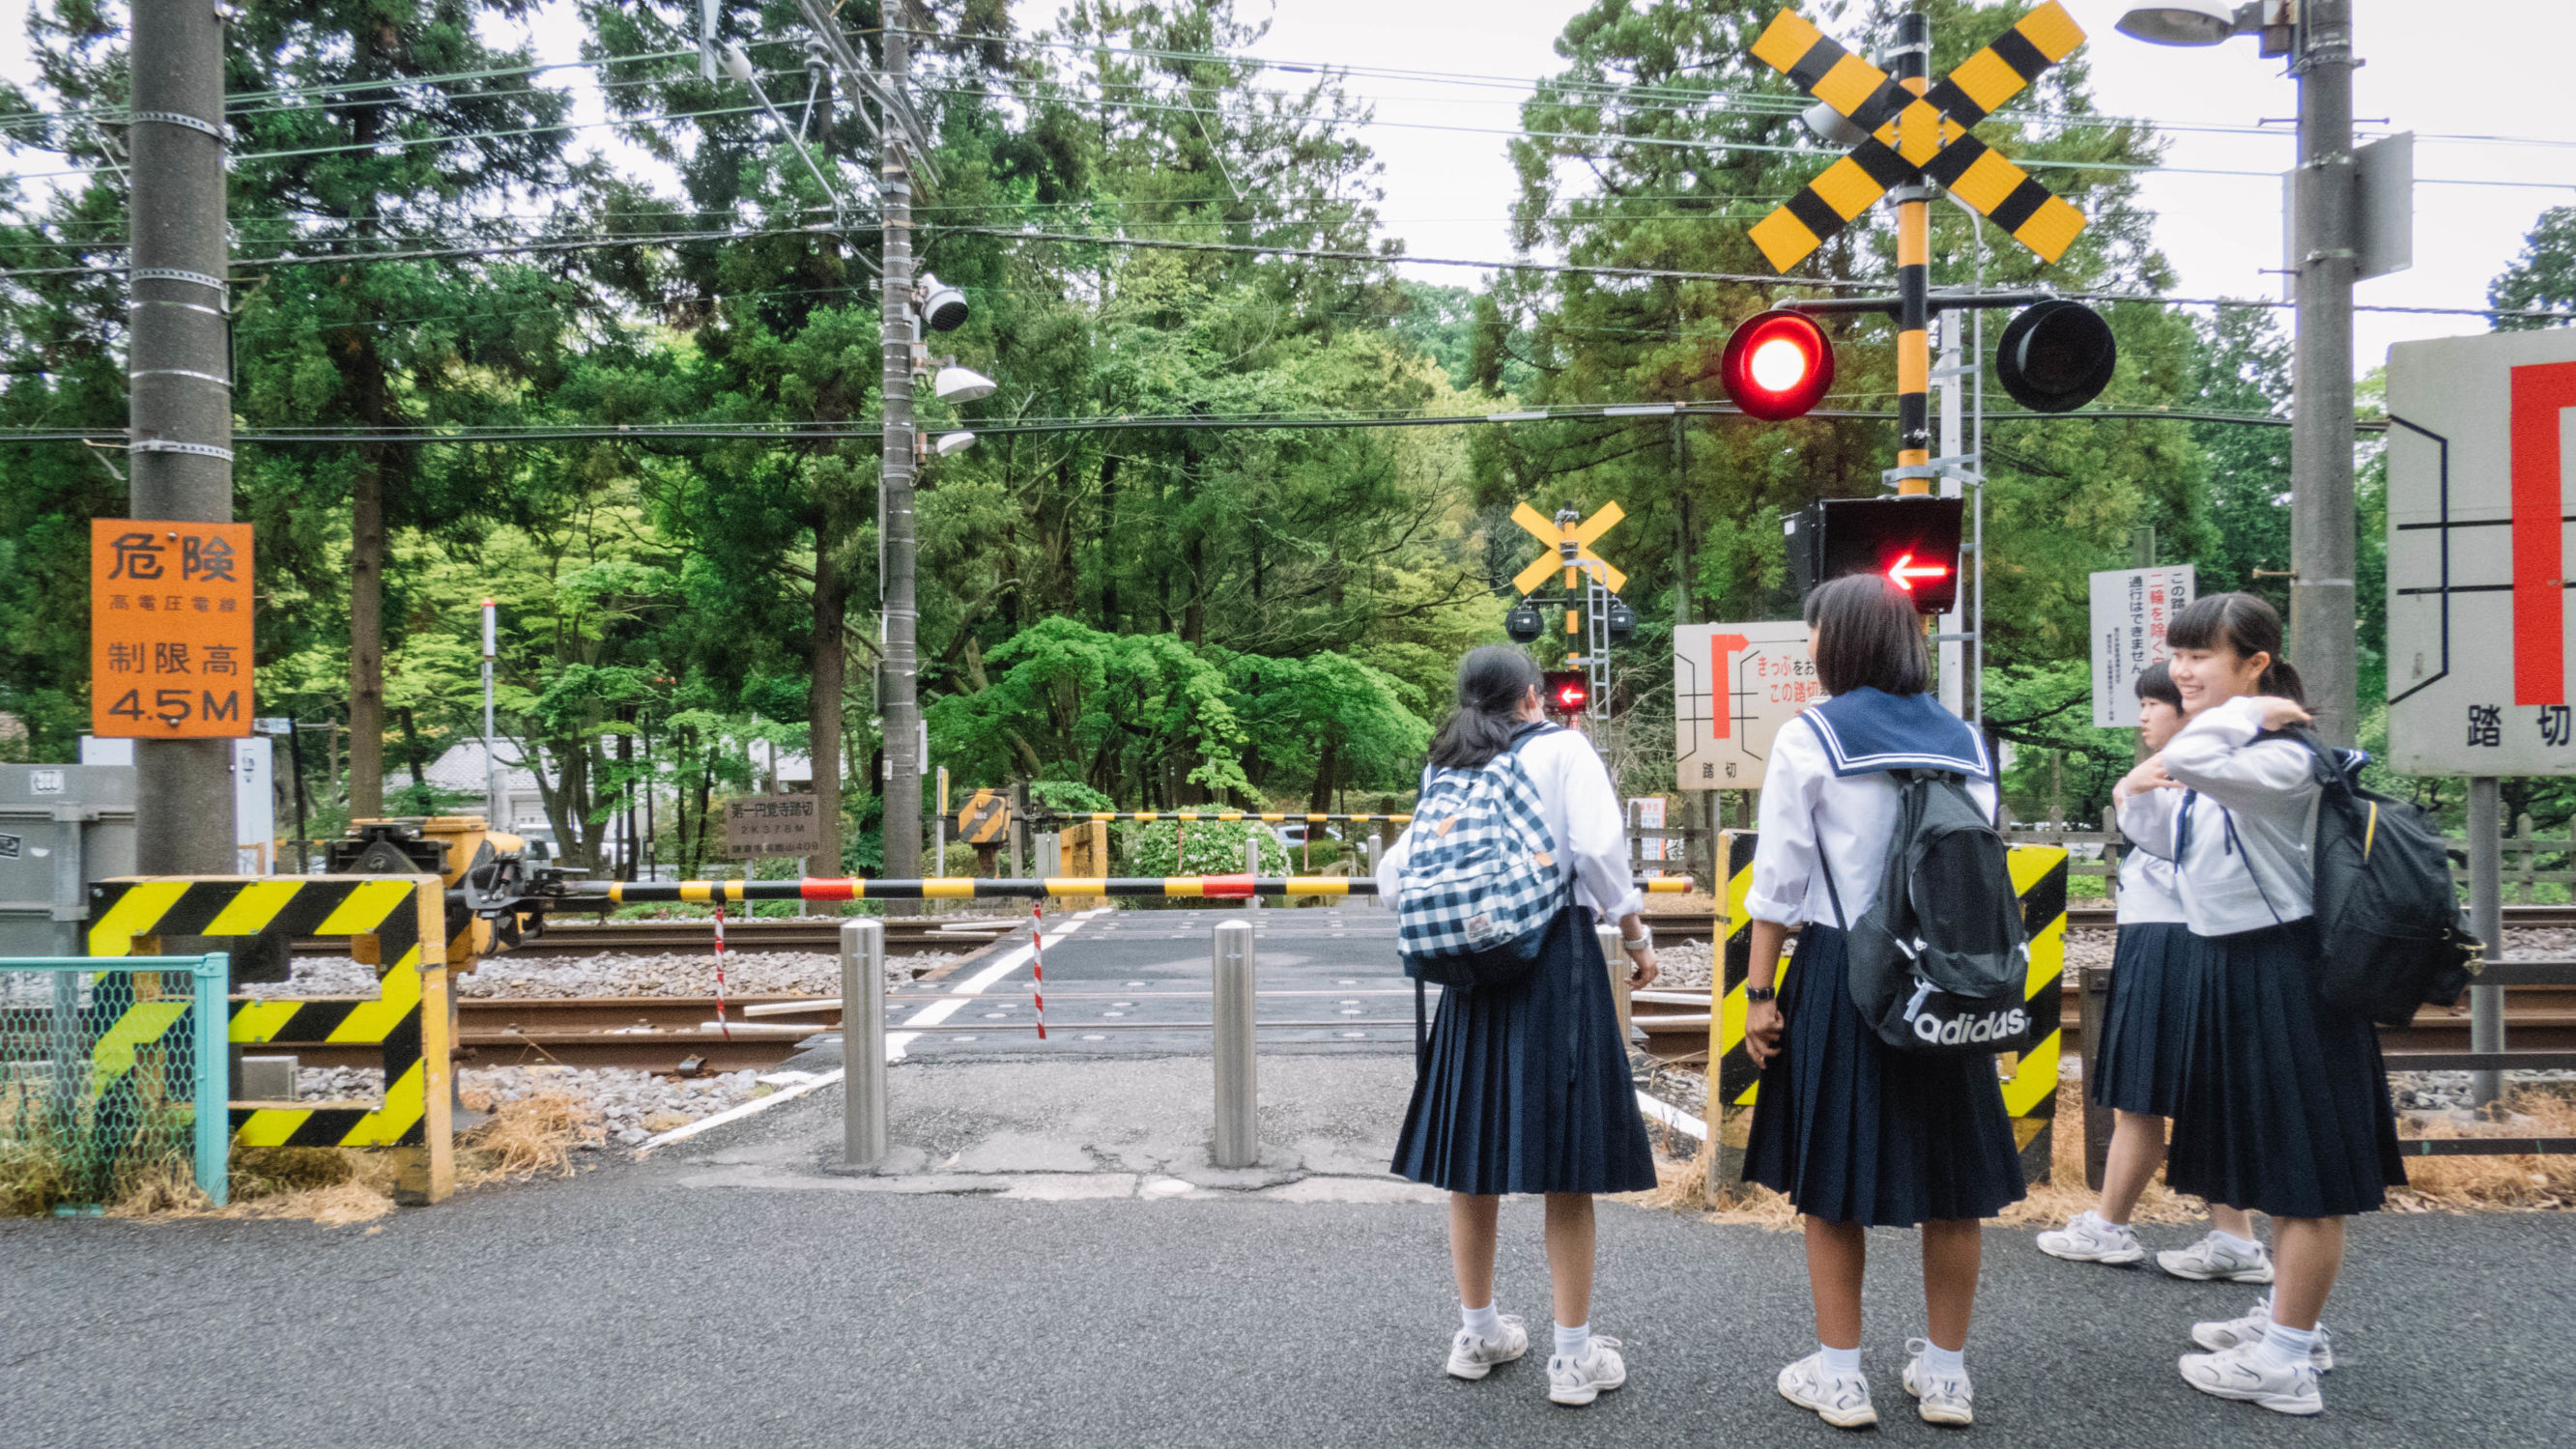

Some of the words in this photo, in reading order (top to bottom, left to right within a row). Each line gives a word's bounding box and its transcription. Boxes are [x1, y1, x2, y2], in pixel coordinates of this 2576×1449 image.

[108, 533, 237, 582] 危険
[109, 594, 237, 612] 高電圧電線
[2170, 573, 2186, 615] この踏
[2129, 576, 2144, 674] 通行はできません
[108, 642, 238, 676] 制限高
[108, 688, 238, 722] 4.5M
[2467, 704, 2571, 747] 踏切
[1703, 761, 1737, 779] 踏切
[1913, 1009, 2026, 1045] adidas
